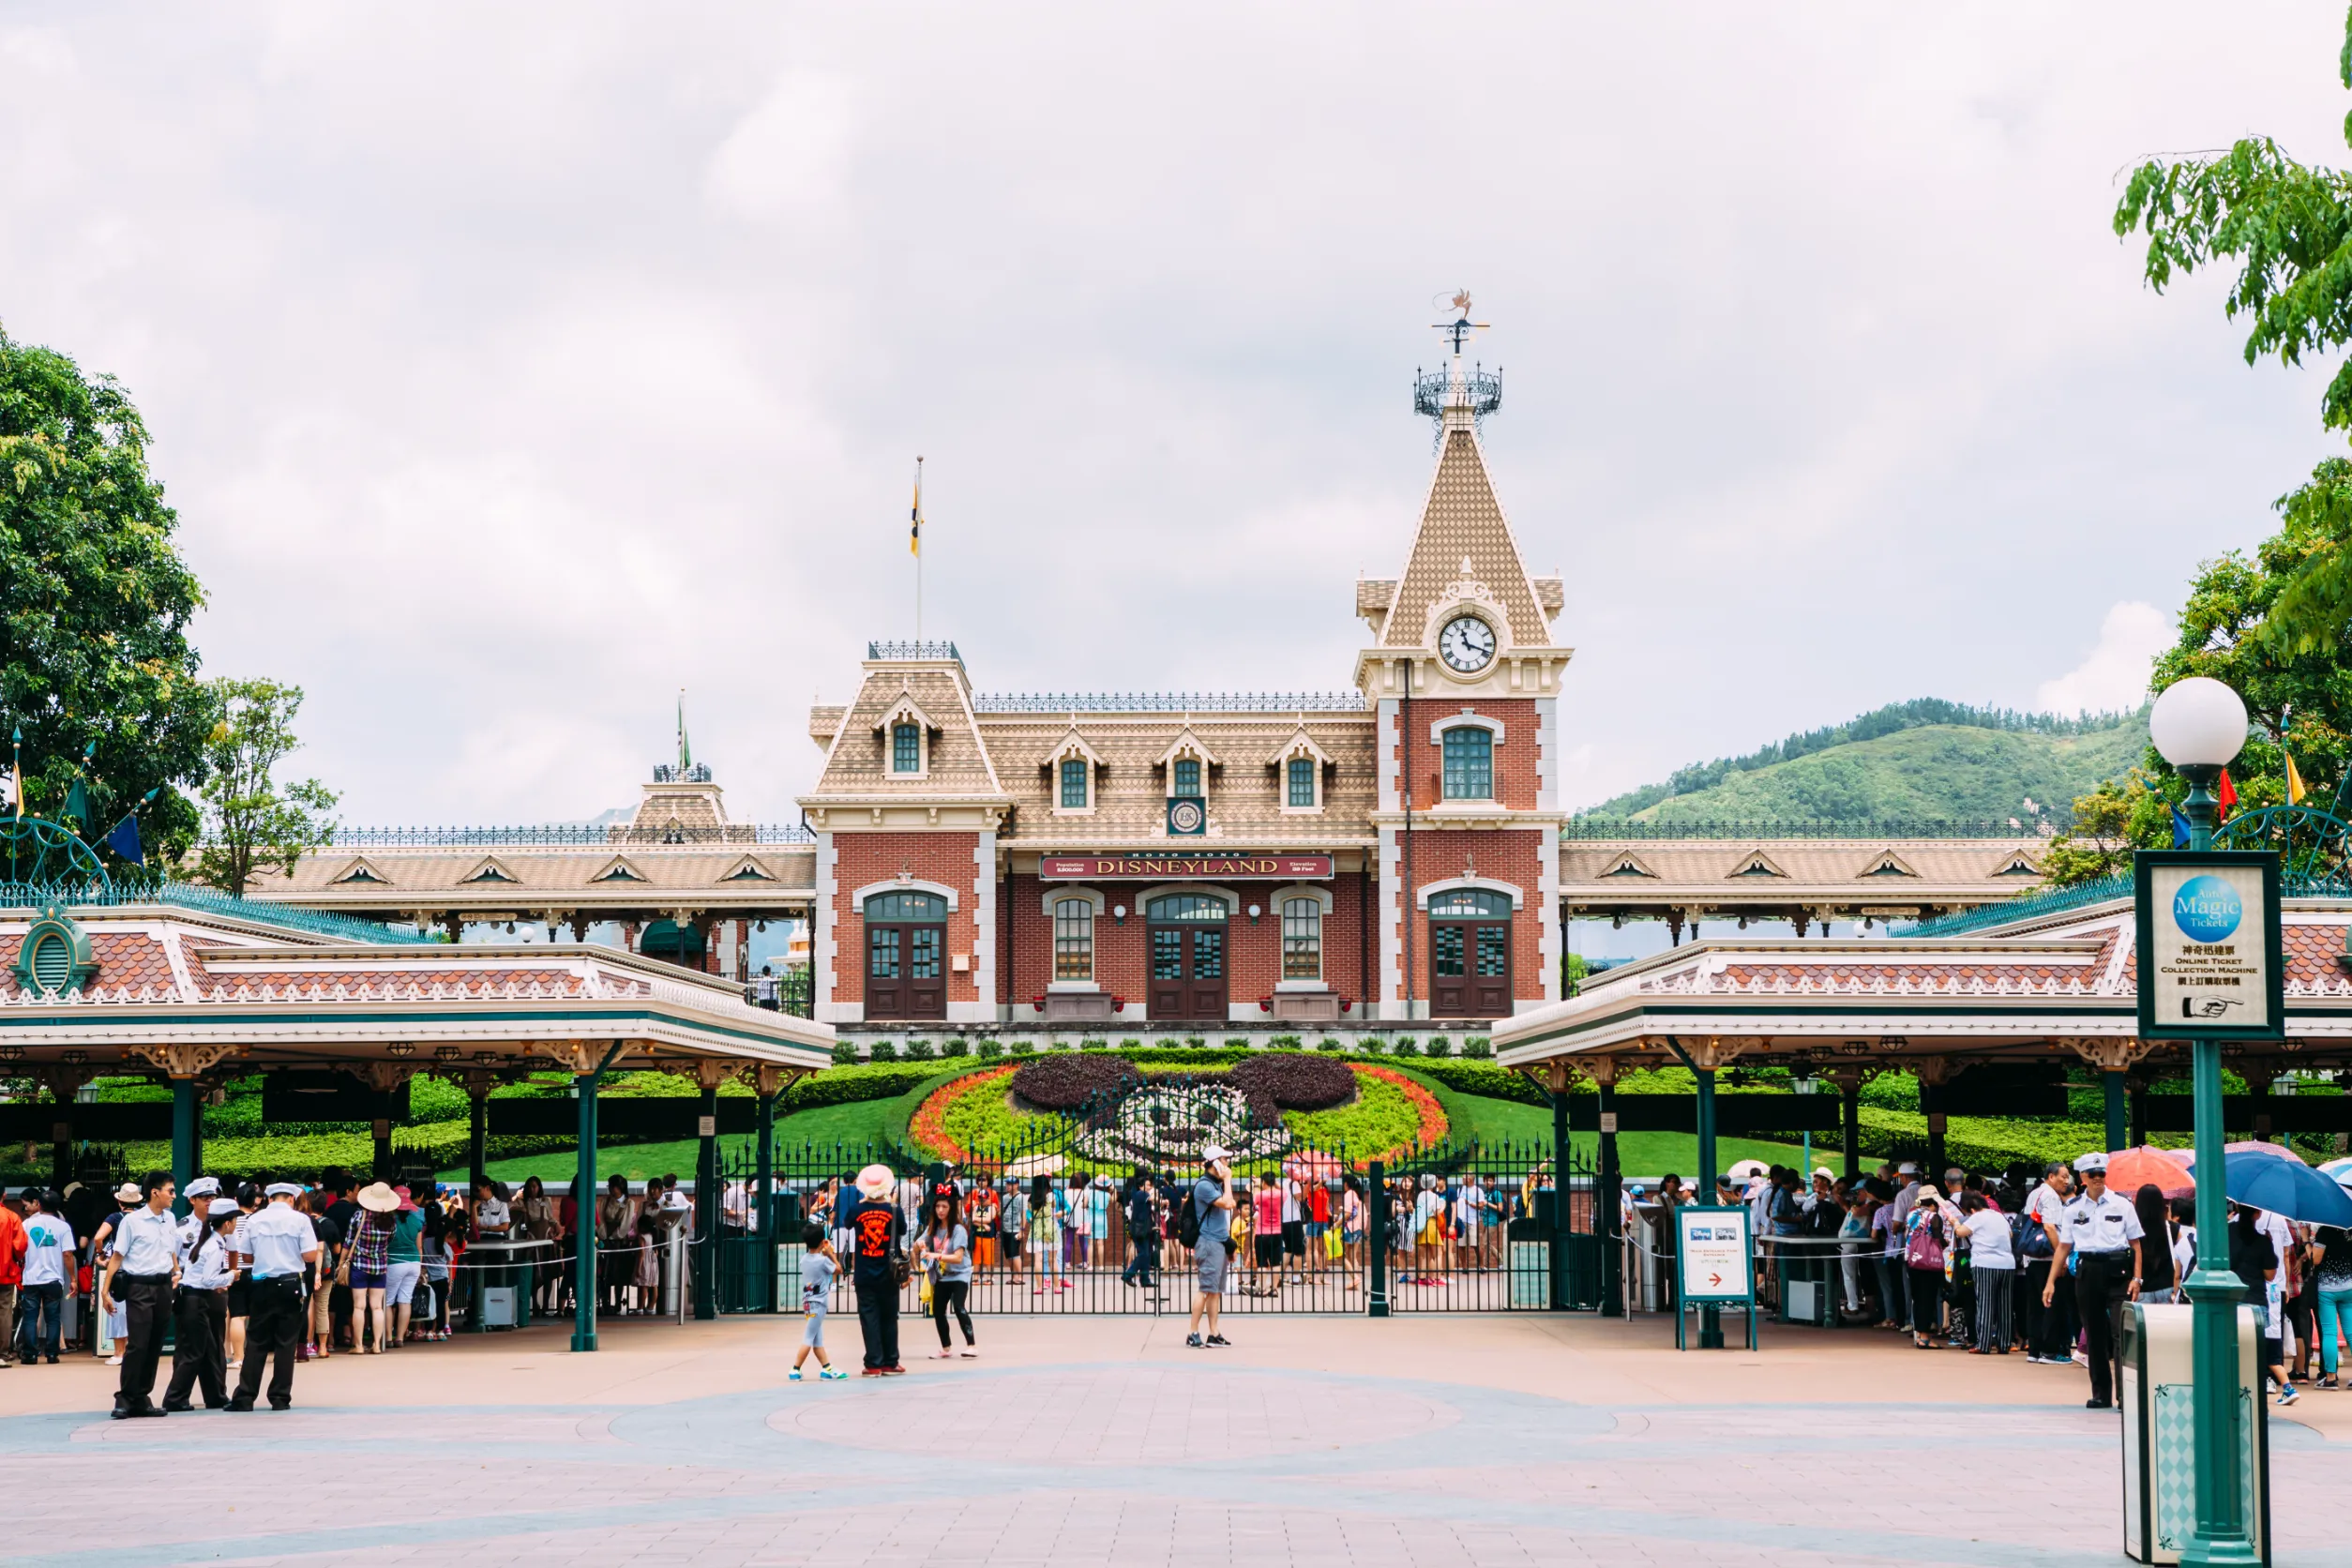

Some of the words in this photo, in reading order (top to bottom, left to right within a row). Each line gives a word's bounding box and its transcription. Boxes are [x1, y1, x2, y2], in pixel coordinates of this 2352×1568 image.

[1096, 861, 1278, 873] DISNEYLAND
[2198, 889, 2222, 898] Auto
[2176, 897, 2239, 920] Magic
[2191, 918, 2228, 927] Tickets
